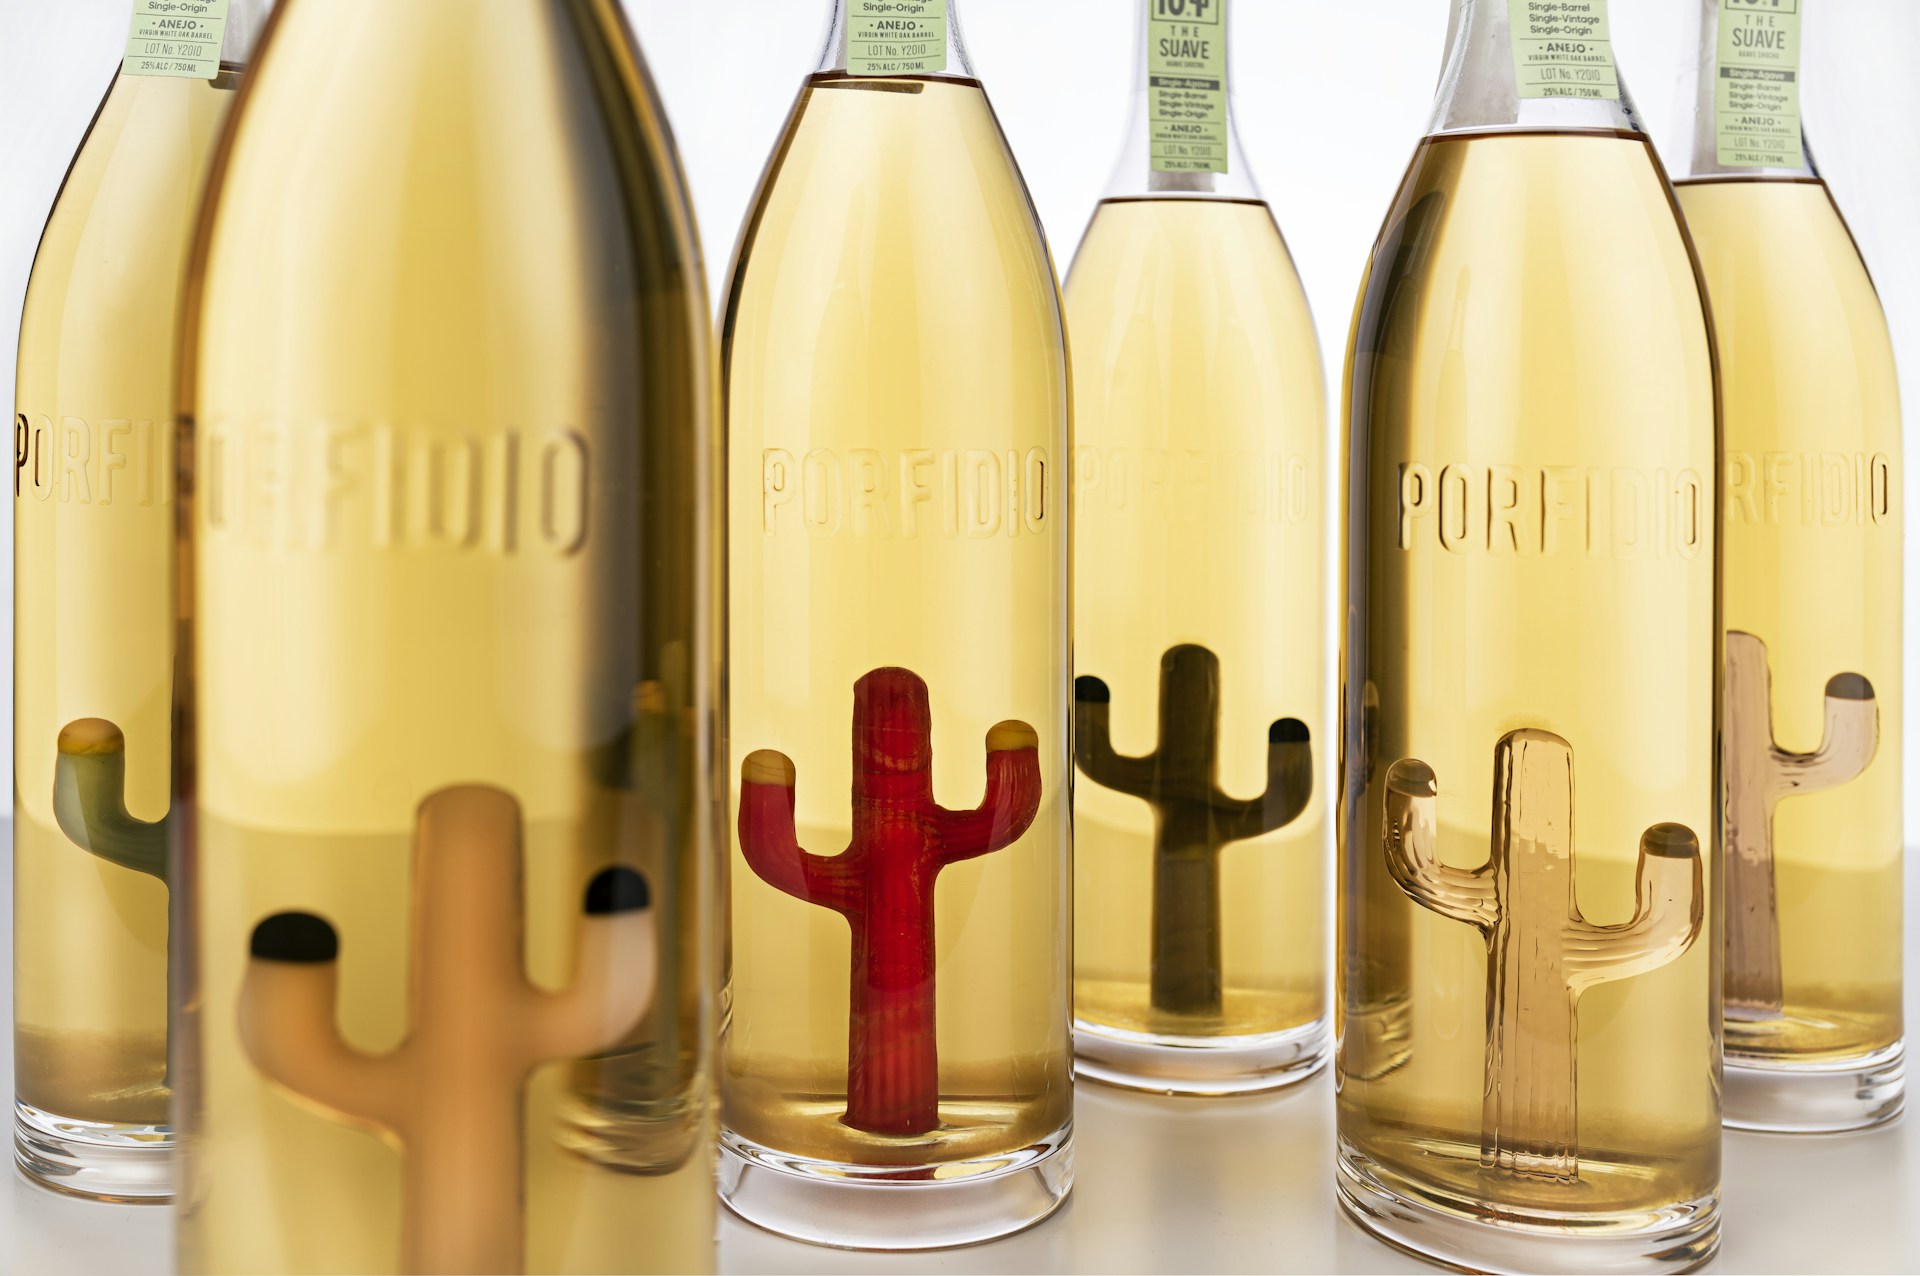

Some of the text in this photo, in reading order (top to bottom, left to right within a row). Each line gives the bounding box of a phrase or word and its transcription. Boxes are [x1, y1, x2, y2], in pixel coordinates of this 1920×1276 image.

[148, 2, 207, 13] Single-Origin
[863, 3, 924, 14] Single-Origin
[1528, 2, 1590, 12] Single-Barrel
[158, 20, 196, 30] ANEJO
[1529, 14, 1600, 25] Single-Vintage
[1745, 14, 1775, 27] THE
[877, 21, 916, 30] ANEJO
[1530, 25, 1592, 36] Single-Origin
[1171, 25, 1199, 38] THE
[1732, 28, 1785, 50] SUAVE
[145, 43, 160, 53] LOT
[868, 45, 883, 56] LOT
[1160, 38, 1209, 59] SUAVE
[1547, 43, 1586, 53] ANEJO
[867, 63, 881, 71] 25%
[1540, 68, 1556, 80] LOT
[1729, 82, 1781, 91] Single-Barrel
[1729, 91, 1788, 102] Single-Vintage
[1729, 101, 1781, 111] Single-Origin
[1741, 117, 1774, 125] ANEJO
[16, 413, 178, 507] PORFI
[762, 446, 1049, 540] PORFIDIO
[1398, 462, 1703, 560] PORFIDIO
